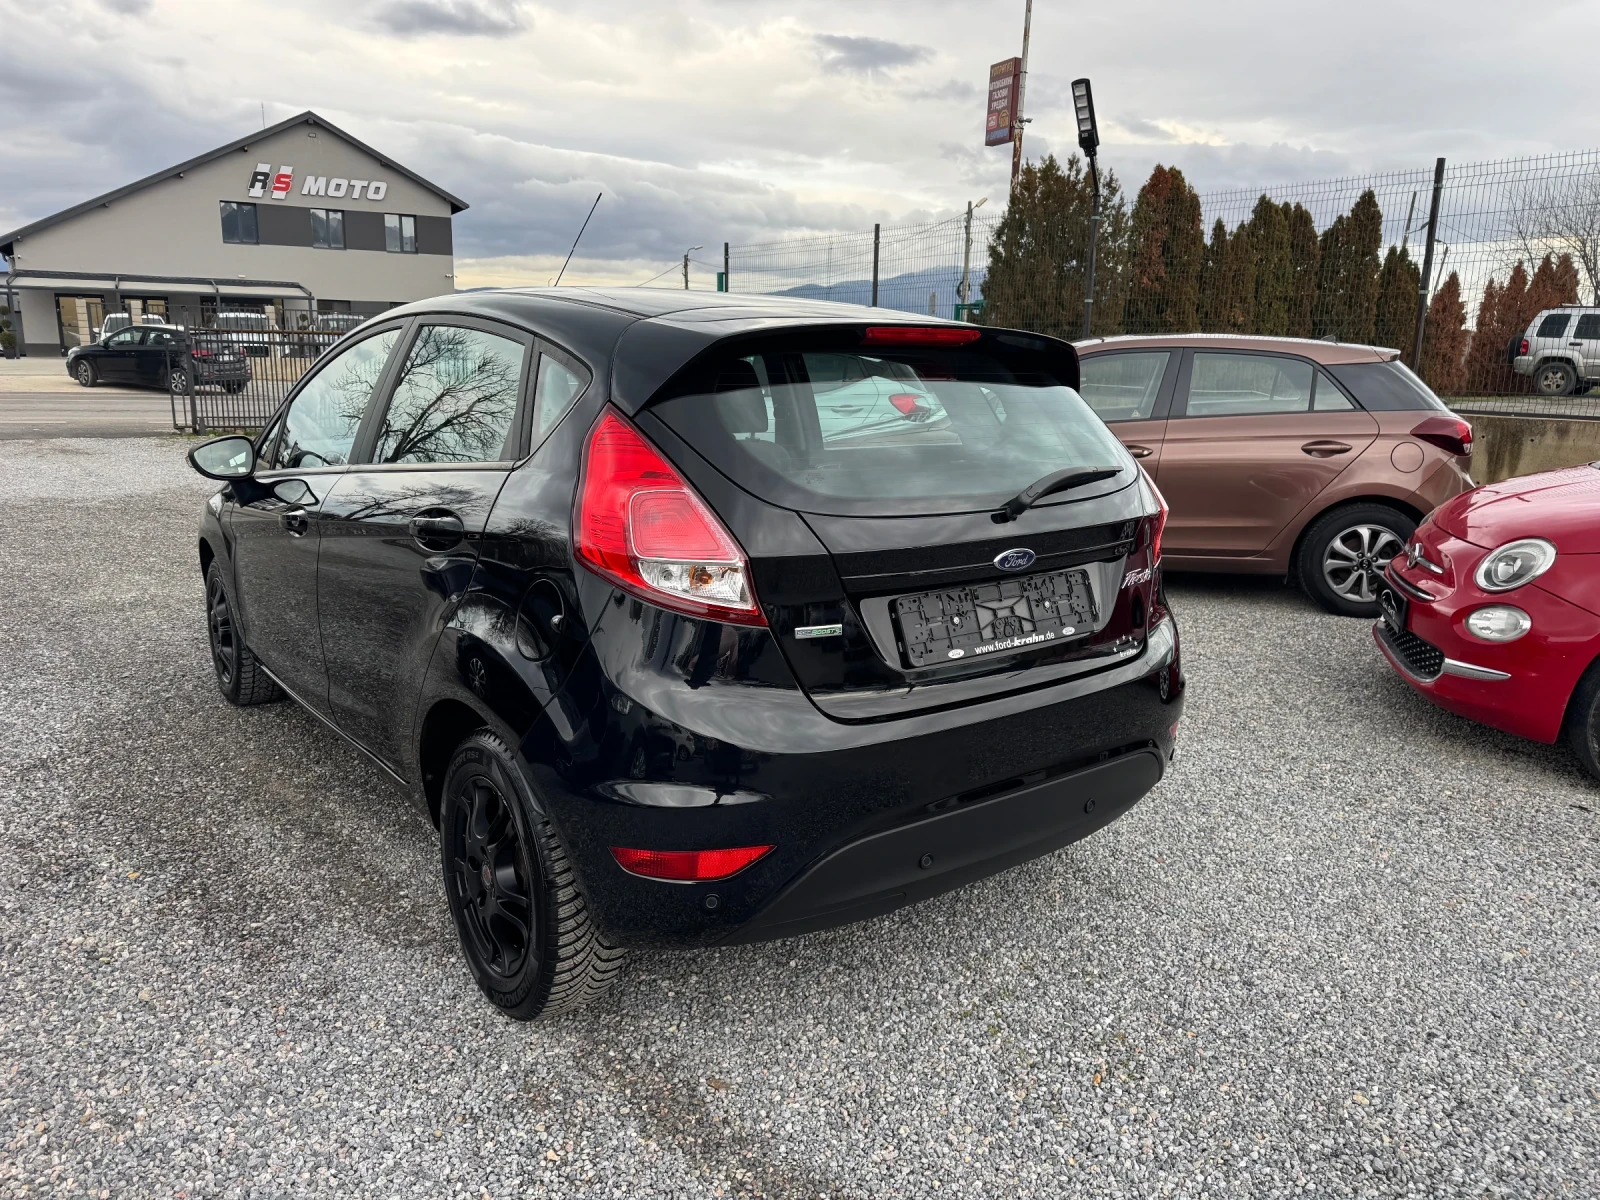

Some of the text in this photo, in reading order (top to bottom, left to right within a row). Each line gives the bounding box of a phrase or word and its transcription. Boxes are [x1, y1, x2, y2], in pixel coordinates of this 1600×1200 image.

[248, 170, 387, 200] RS MOTO
[974, 631, 1055, 655] www.ford-krahn.de
